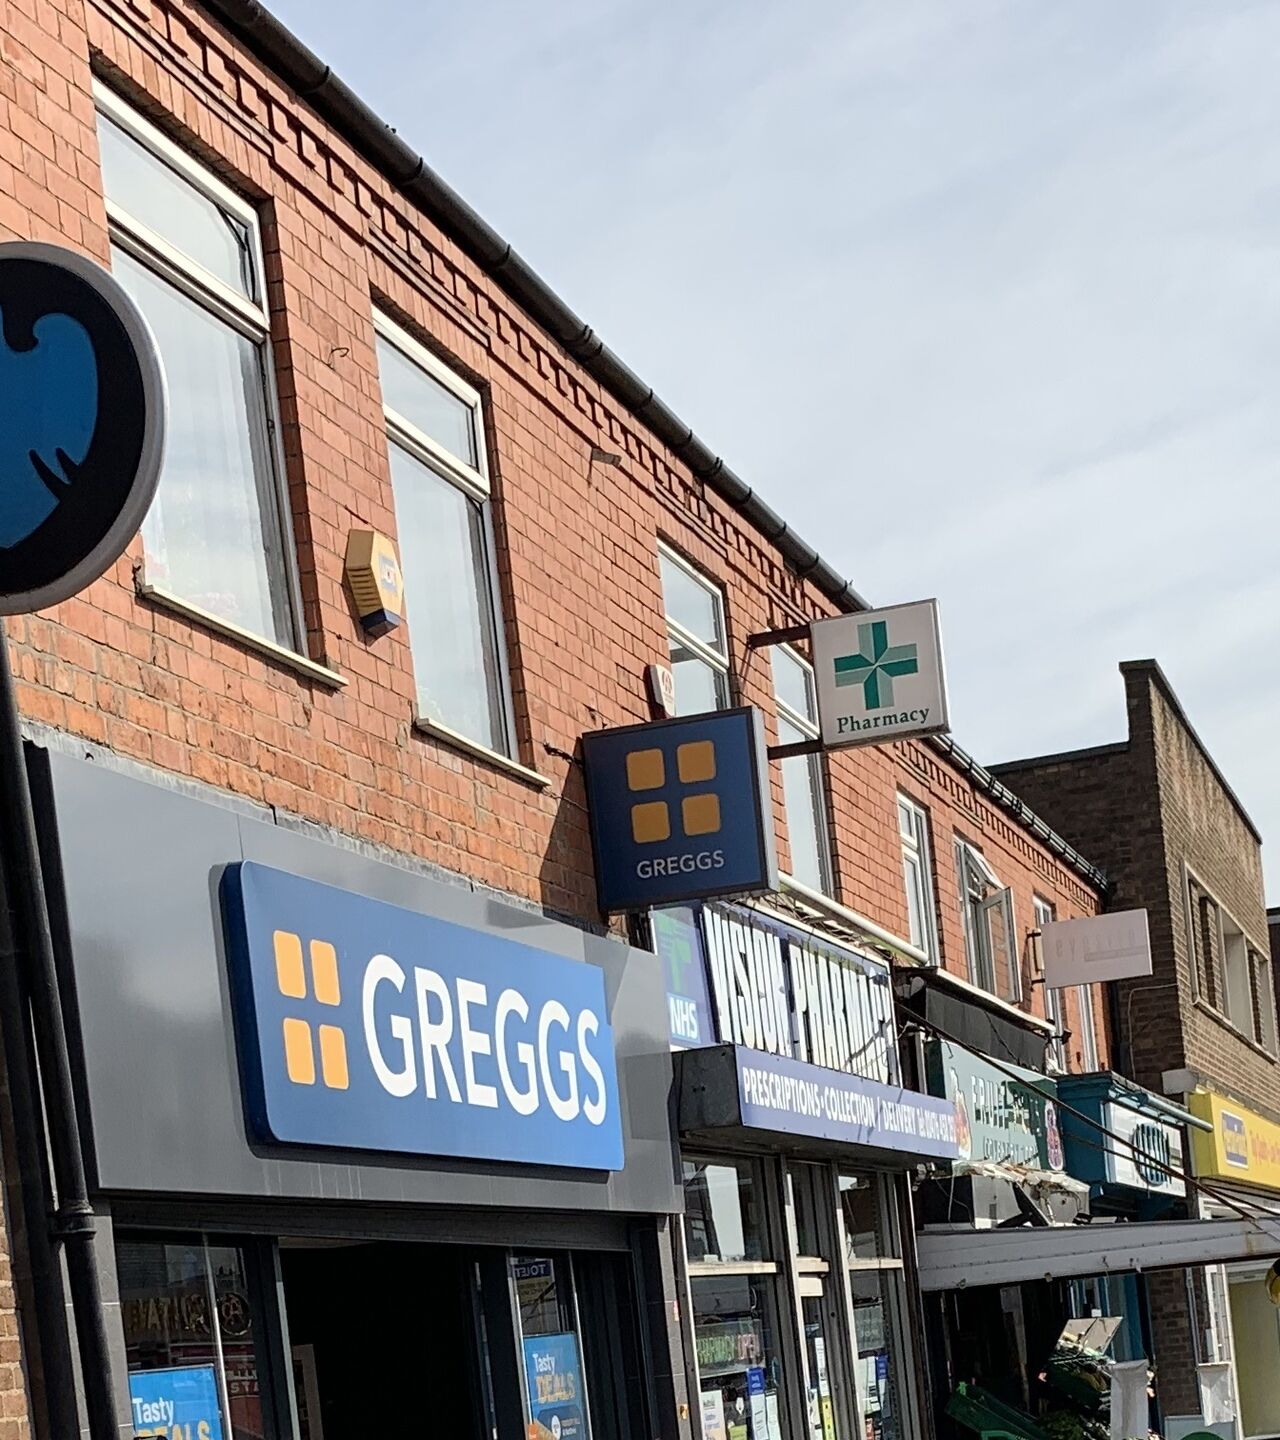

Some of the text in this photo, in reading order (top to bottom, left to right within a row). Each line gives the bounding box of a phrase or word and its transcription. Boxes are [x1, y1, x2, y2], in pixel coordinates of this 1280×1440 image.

[837, 707, 930, 734] Pharmacy
[637, 850, 725, 879] GREGGS
[670, 996, 698, 1039] NHS
[362, 954, 607, 1126] GREGGS
[742, 1067, 820, 1118] PRESCRIPTIONS
[824, 1086, 876, 1128] COLLECTION
[882, 1100, 917, 1135] DELIVERY
[532, 1353, 555, 1375] Tasty
[132, 1396, 174, 1427] Tasty
